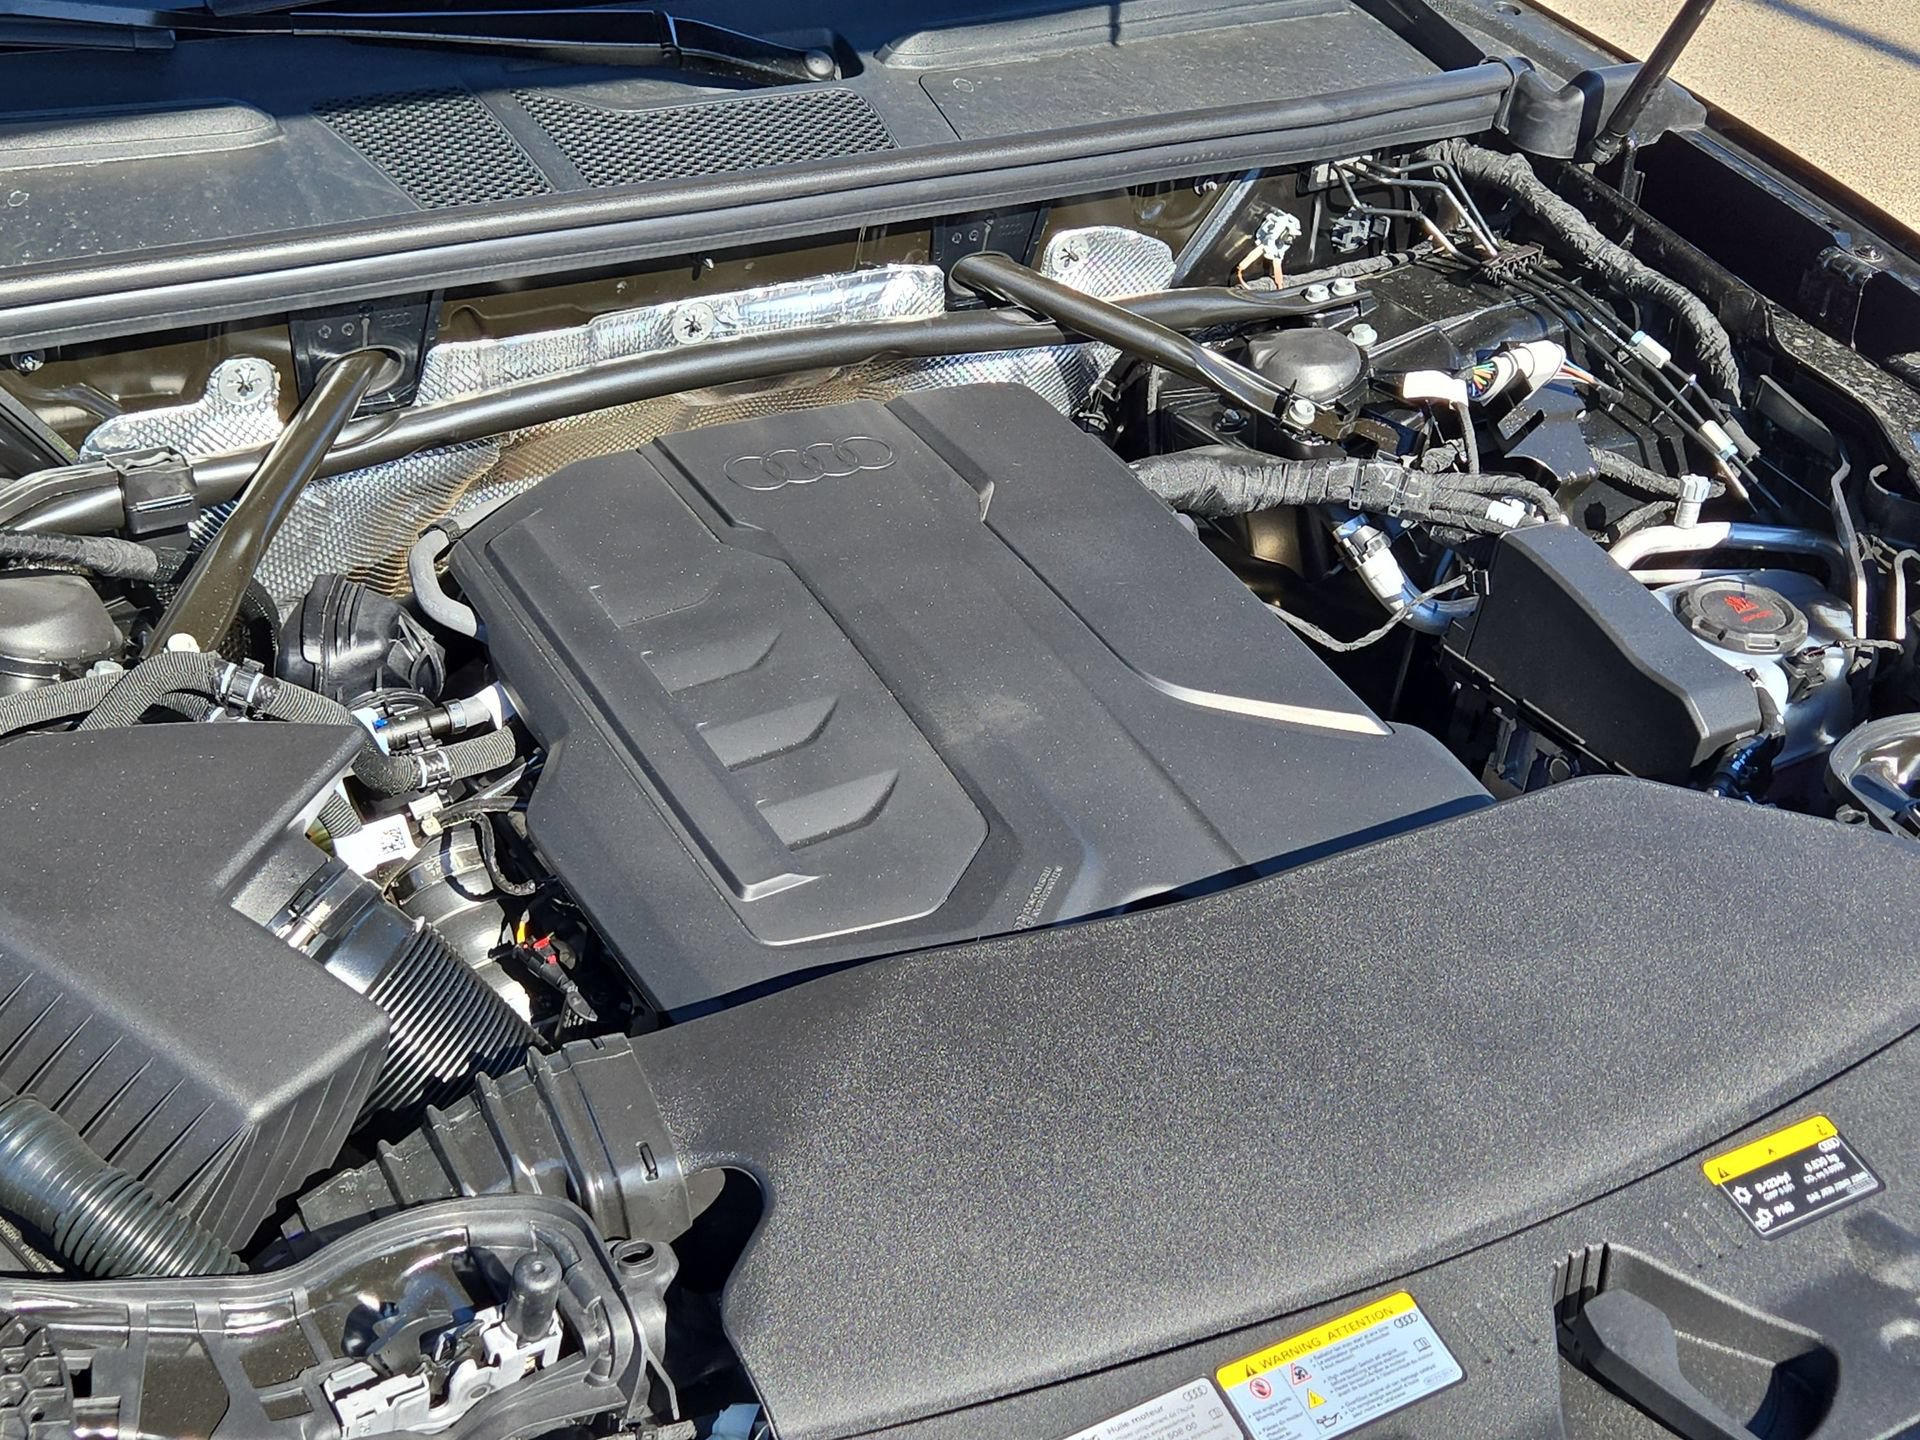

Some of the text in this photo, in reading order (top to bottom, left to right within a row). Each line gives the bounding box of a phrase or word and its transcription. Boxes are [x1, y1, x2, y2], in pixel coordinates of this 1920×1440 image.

[1260, 1337, 1321, 1369] WARNING
[1327, 1306, 1394, 1341] ATTENTION
[1131, 1405, 1163, 1424] moteur
